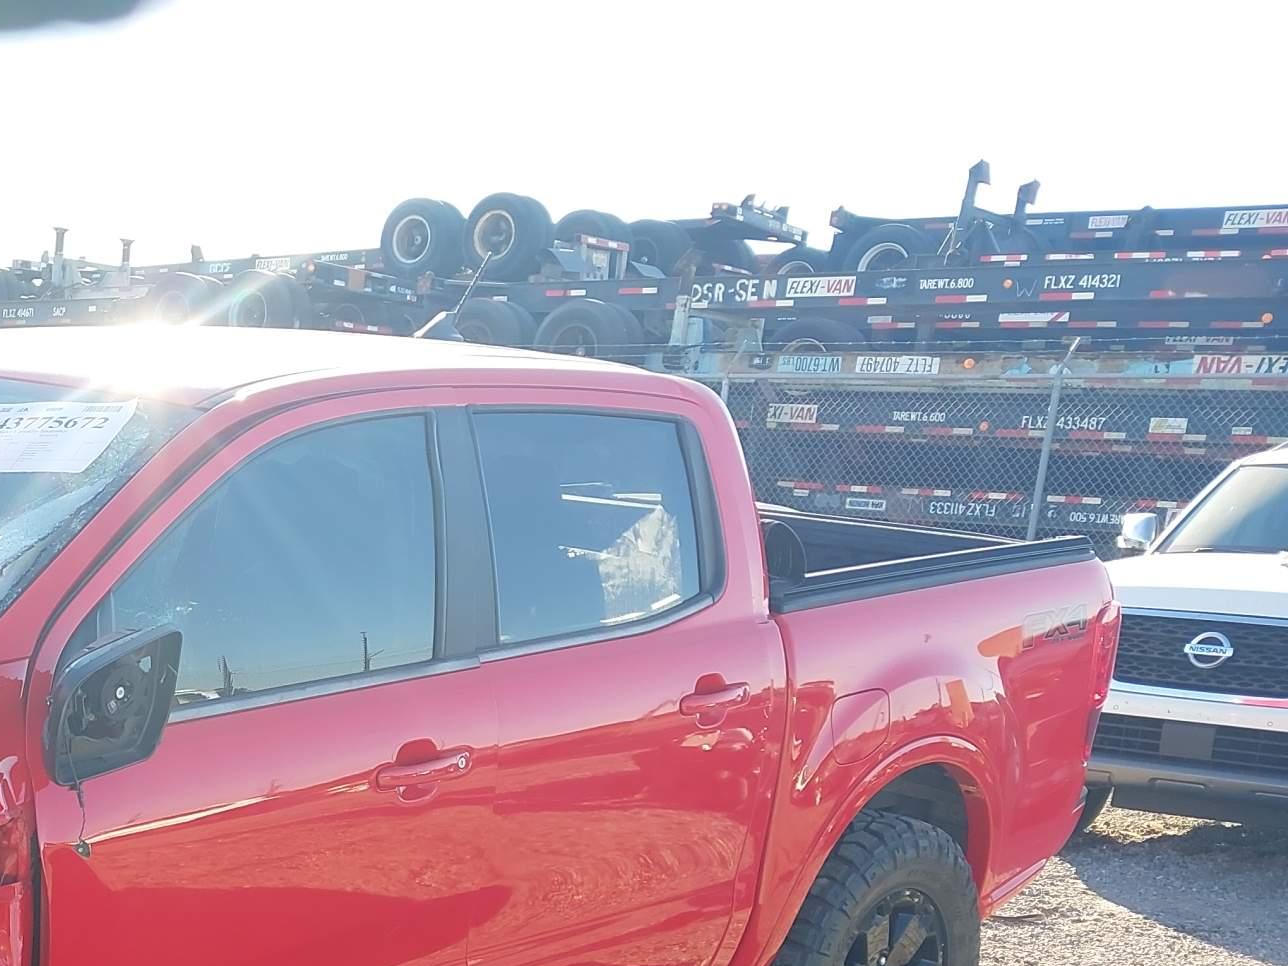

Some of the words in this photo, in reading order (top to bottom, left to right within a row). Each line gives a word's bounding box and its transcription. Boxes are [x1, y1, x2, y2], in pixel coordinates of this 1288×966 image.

[789, 278, 854, 295] FLEXI-VAN
[1044, 275, 1075, 289] FLXZ
[1079, 274, 1121, 288] 414321
[906, 357, 933, 373] FLTZ
[1056, 417, 1106, 430] 433487
[1022, 602, 1088, 648] FX4
[1189, 646, 1228, 655] NISSAN
